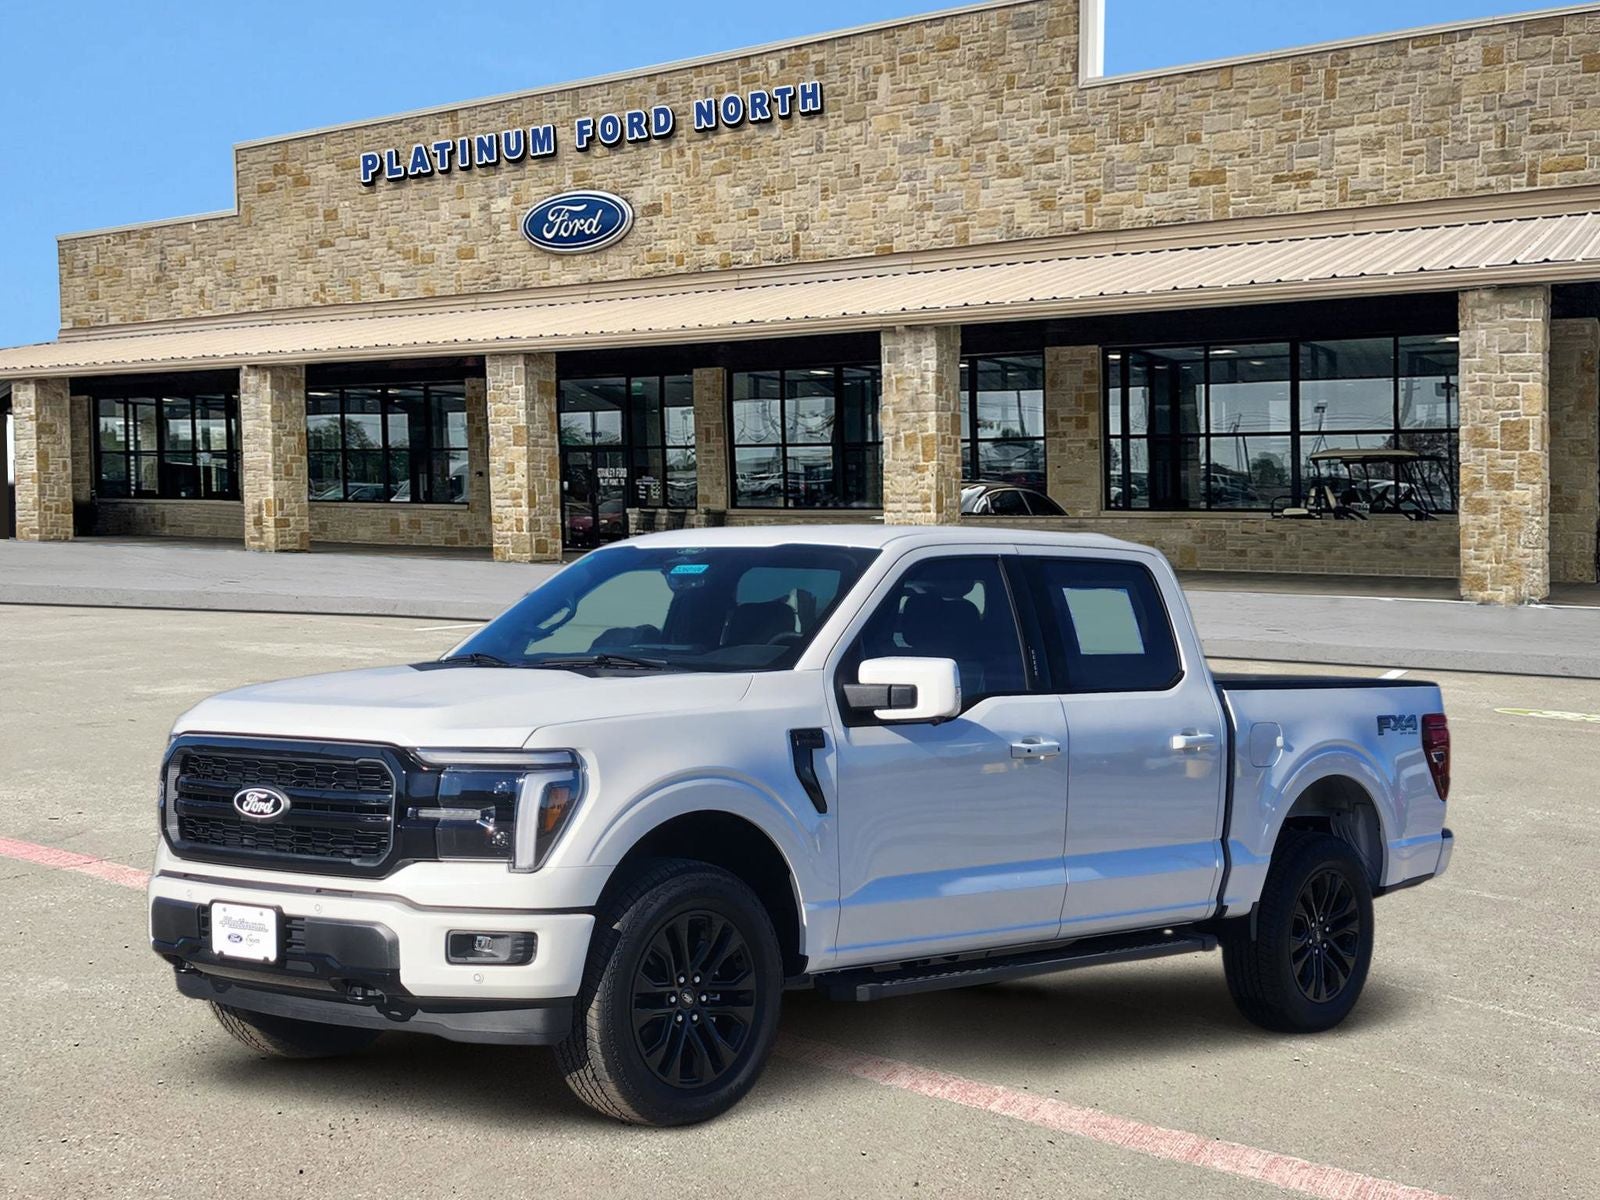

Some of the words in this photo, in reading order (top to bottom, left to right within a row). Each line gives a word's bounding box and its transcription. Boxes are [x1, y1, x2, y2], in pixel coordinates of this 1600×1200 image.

[360, 125, 556, 186] PLATINUM
[575, 105, 674, 152] FORD
[694, 81, 824, 132] NORTH
[542, 203, 603, 239] Ford
[1377, 714, 1418, 736] FX4
[242, 791, 275, 814] Ford
